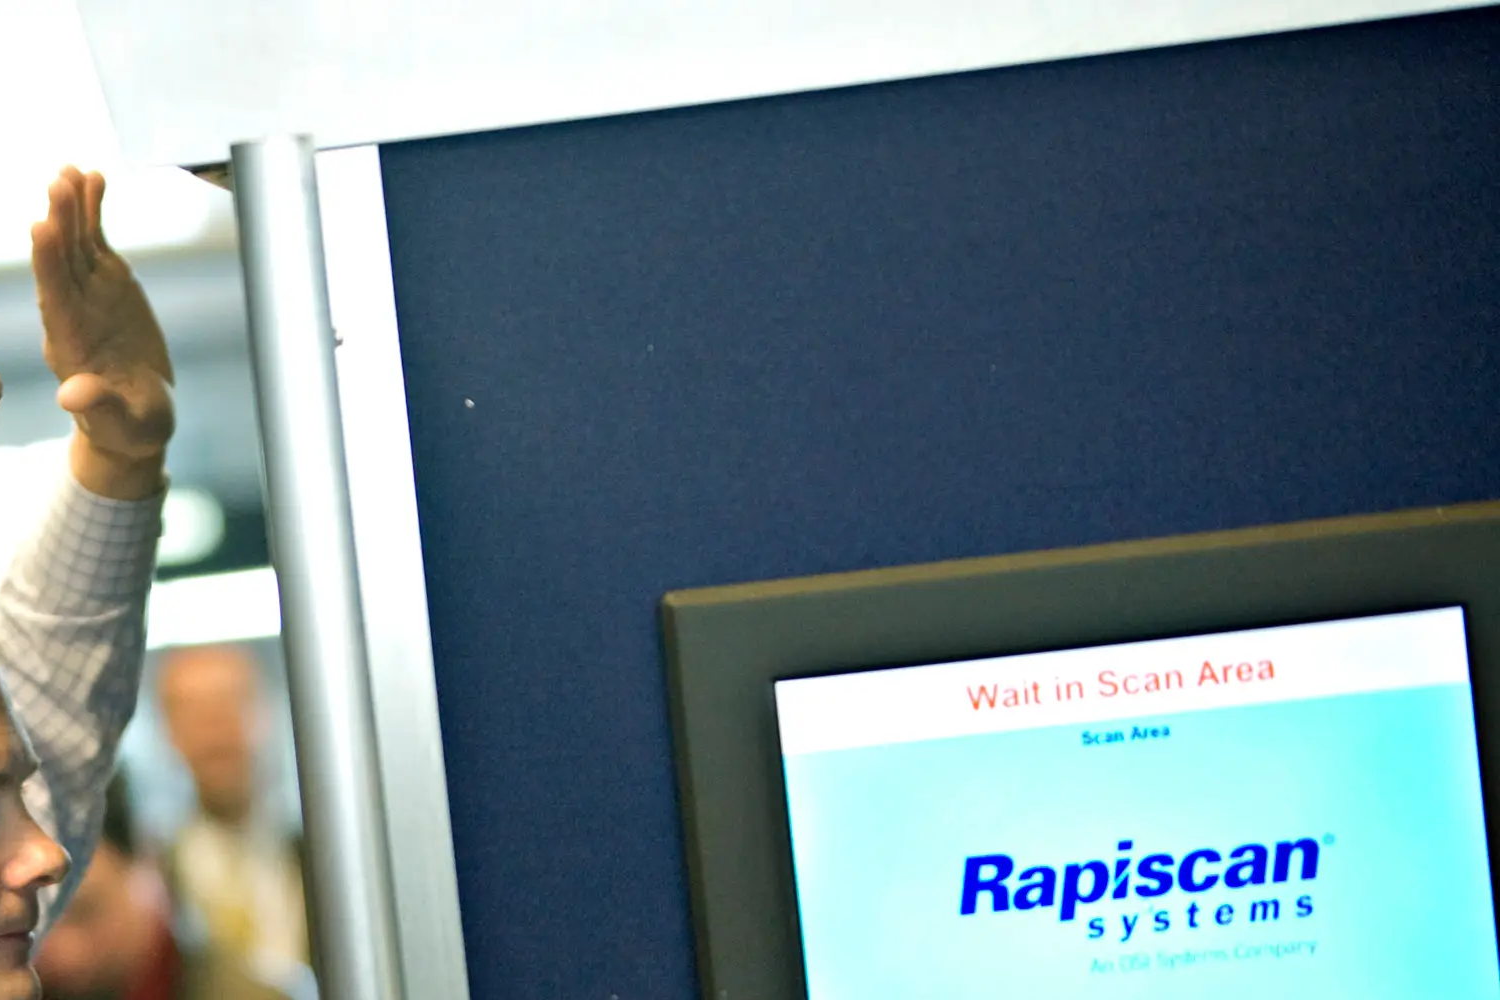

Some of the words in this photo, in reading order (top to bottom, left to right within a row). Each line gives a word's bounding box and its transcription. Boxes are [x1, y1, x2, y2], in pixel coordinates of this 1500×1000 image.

[966, 680, 1041, 711] Wait
[1055, 676, 1084, 702] in
[1097, 669, 1183, 698] Scan
[1197, 659, 1275, 687] Area
[1081, 730, 1125, 746] Scan
[1131, 726, 1171, 741] Area
[959, 836, 1321, 922] Rapiscan
[1087, 894, 1314, 943] systems
[1157, 949, 1229, 969] Systems
[1233, 940, 1317, 960] Company
